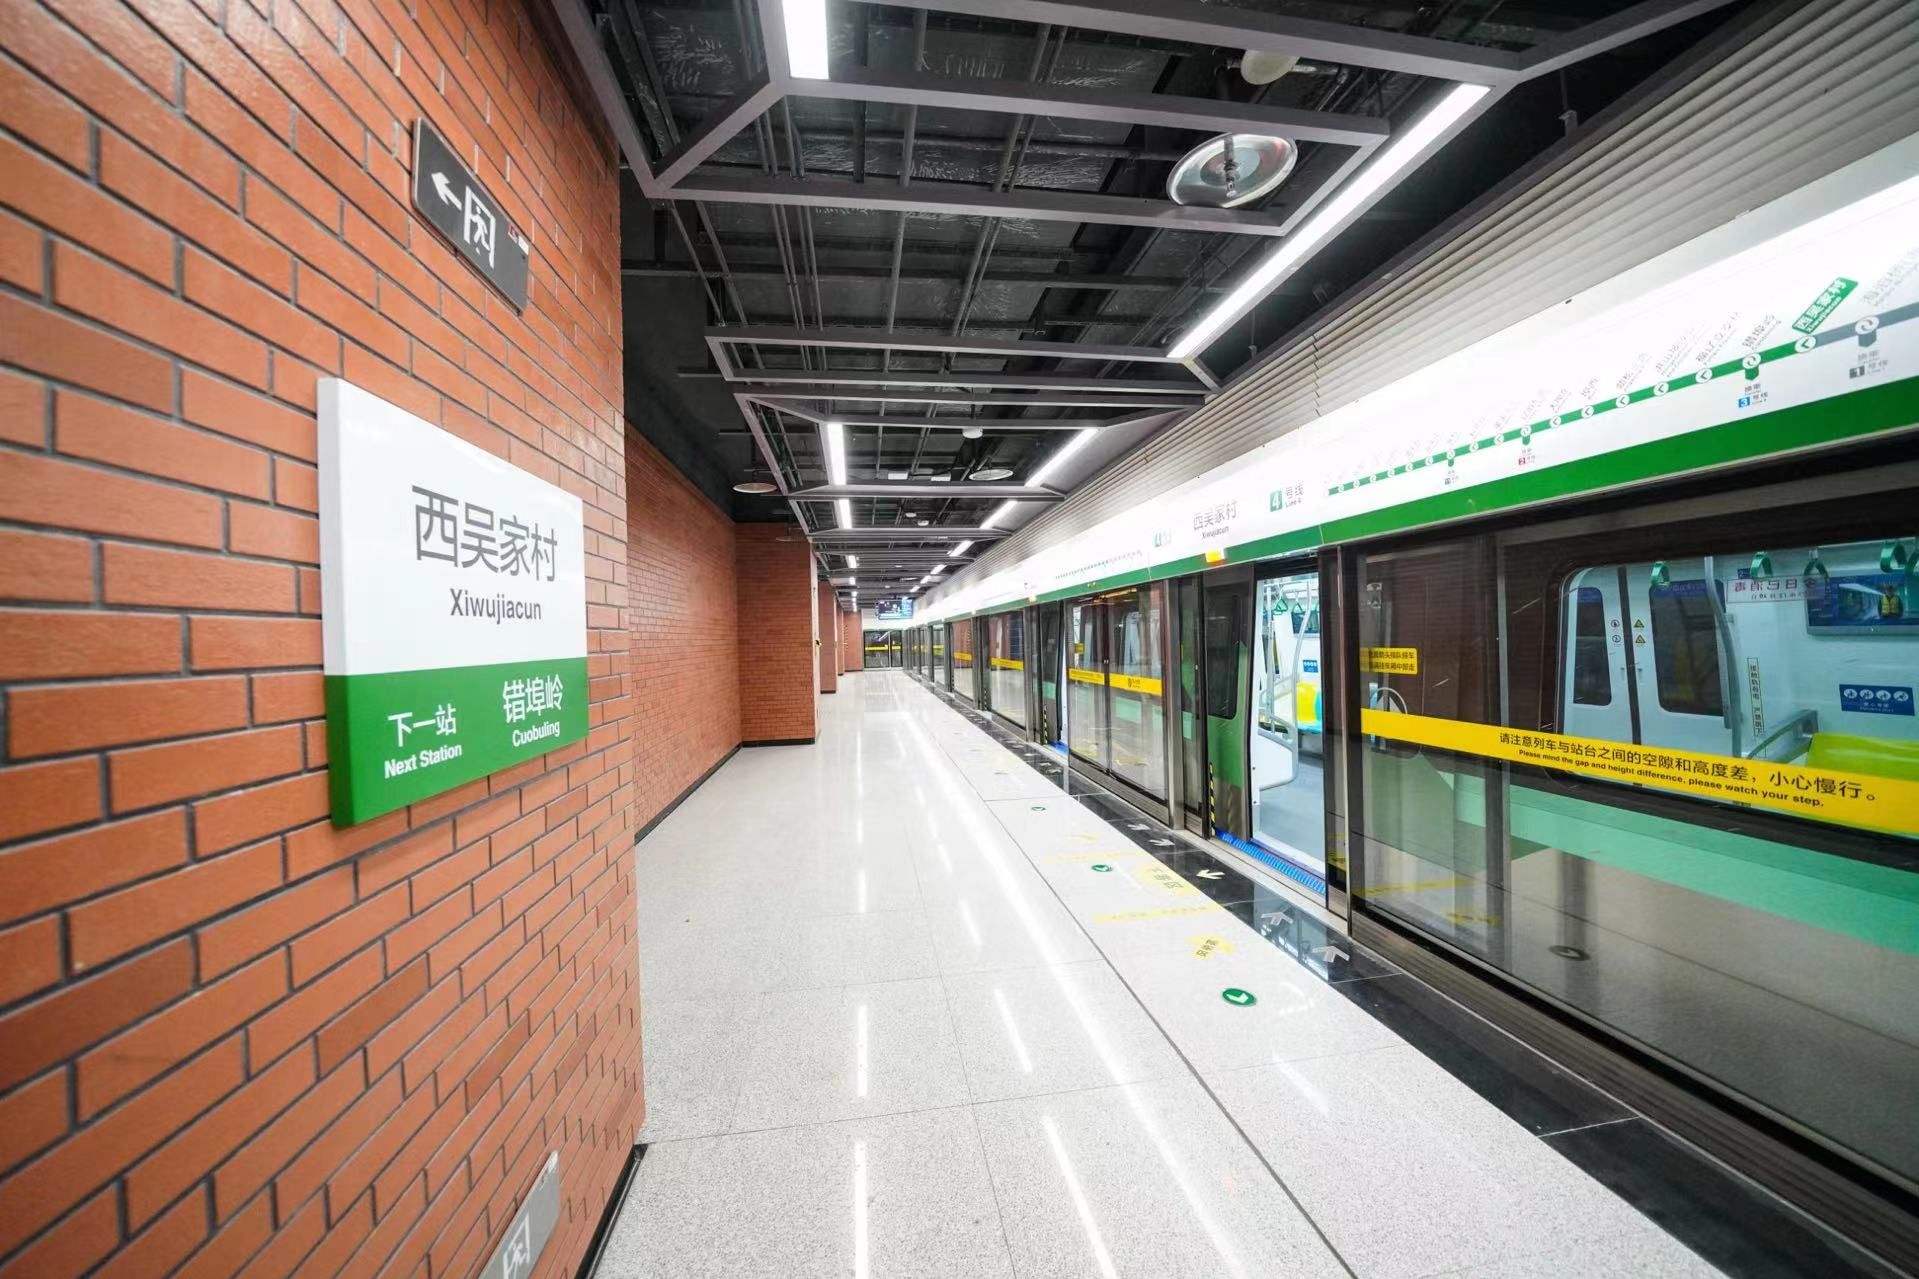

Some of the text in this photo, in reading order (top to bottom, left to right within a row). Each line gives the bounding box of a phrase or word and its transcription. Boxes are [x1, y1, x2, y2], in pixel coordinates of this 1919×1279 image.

[412, 485, 558, 582] 西吴家村
[450, 588, 542, 625] Xiwujiacun
[502, 673, 564, 724] 错埠岭
[387, 703, 457, 747] 下一站
[512, 721, 560, 747] Cuobuling
[384, 744, 463, 779] Next Station
[1500, 732, 1875, 801] 请注意列车与站台之间的空隙和高度差，小心慢行。
[1518, 749, 1824, 807] Please mind the gap and height difference, please watch your step.
